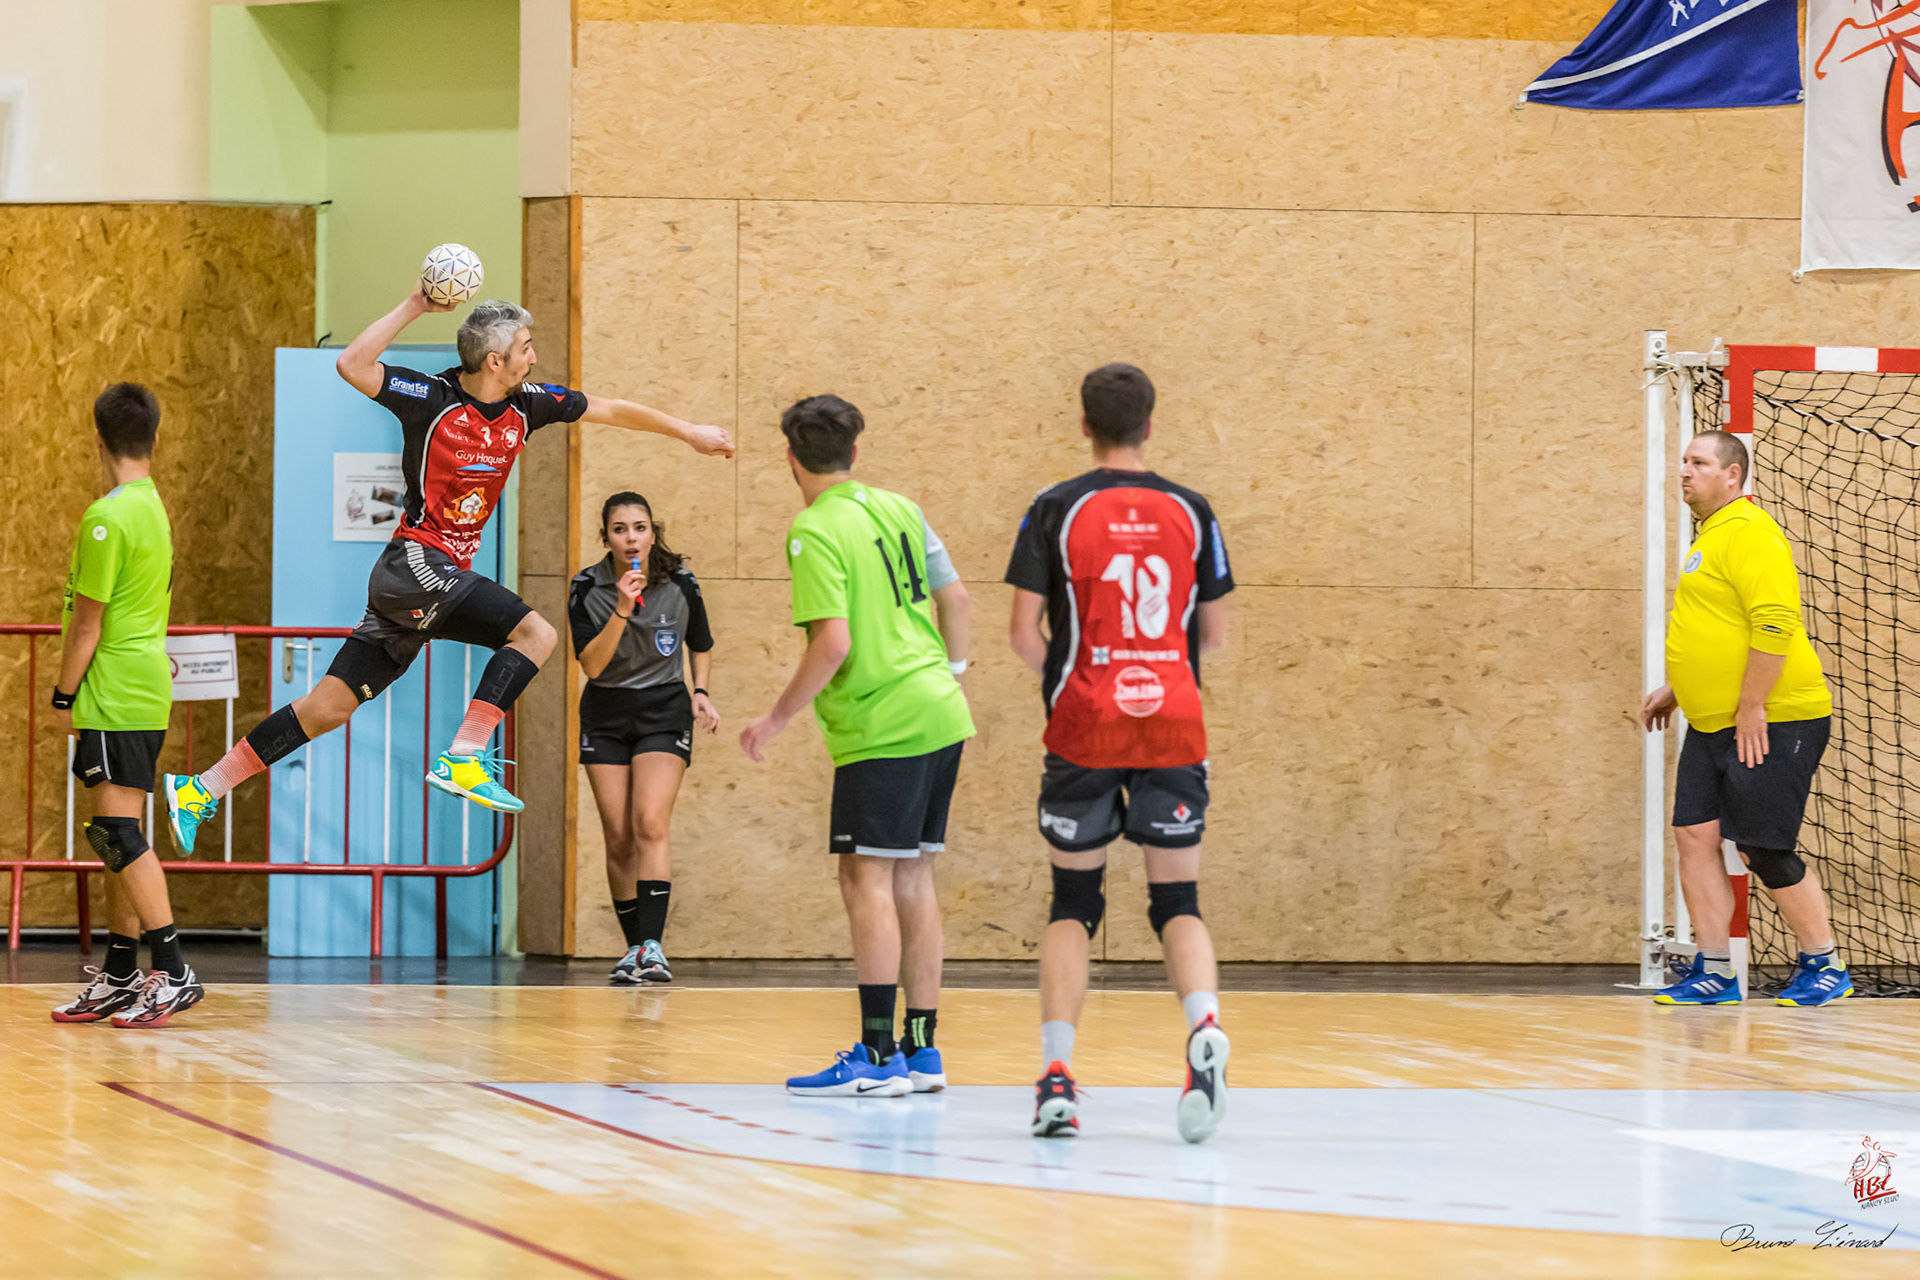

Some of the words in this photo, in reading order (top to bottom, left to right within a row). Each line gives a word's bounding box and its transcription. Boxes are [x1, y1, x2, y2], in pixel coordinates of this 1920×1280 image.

[390, 377, 415, 391] Grand
[415, 383, 429, 394] Est
[453, 420, 470, 428] SELECT
[455, 449, 475, 463] Guy
[476, 452, 508, 465] Hoquet
[874, 532, 927, 607] 14
[1100, 554, 1171, 639] 18
